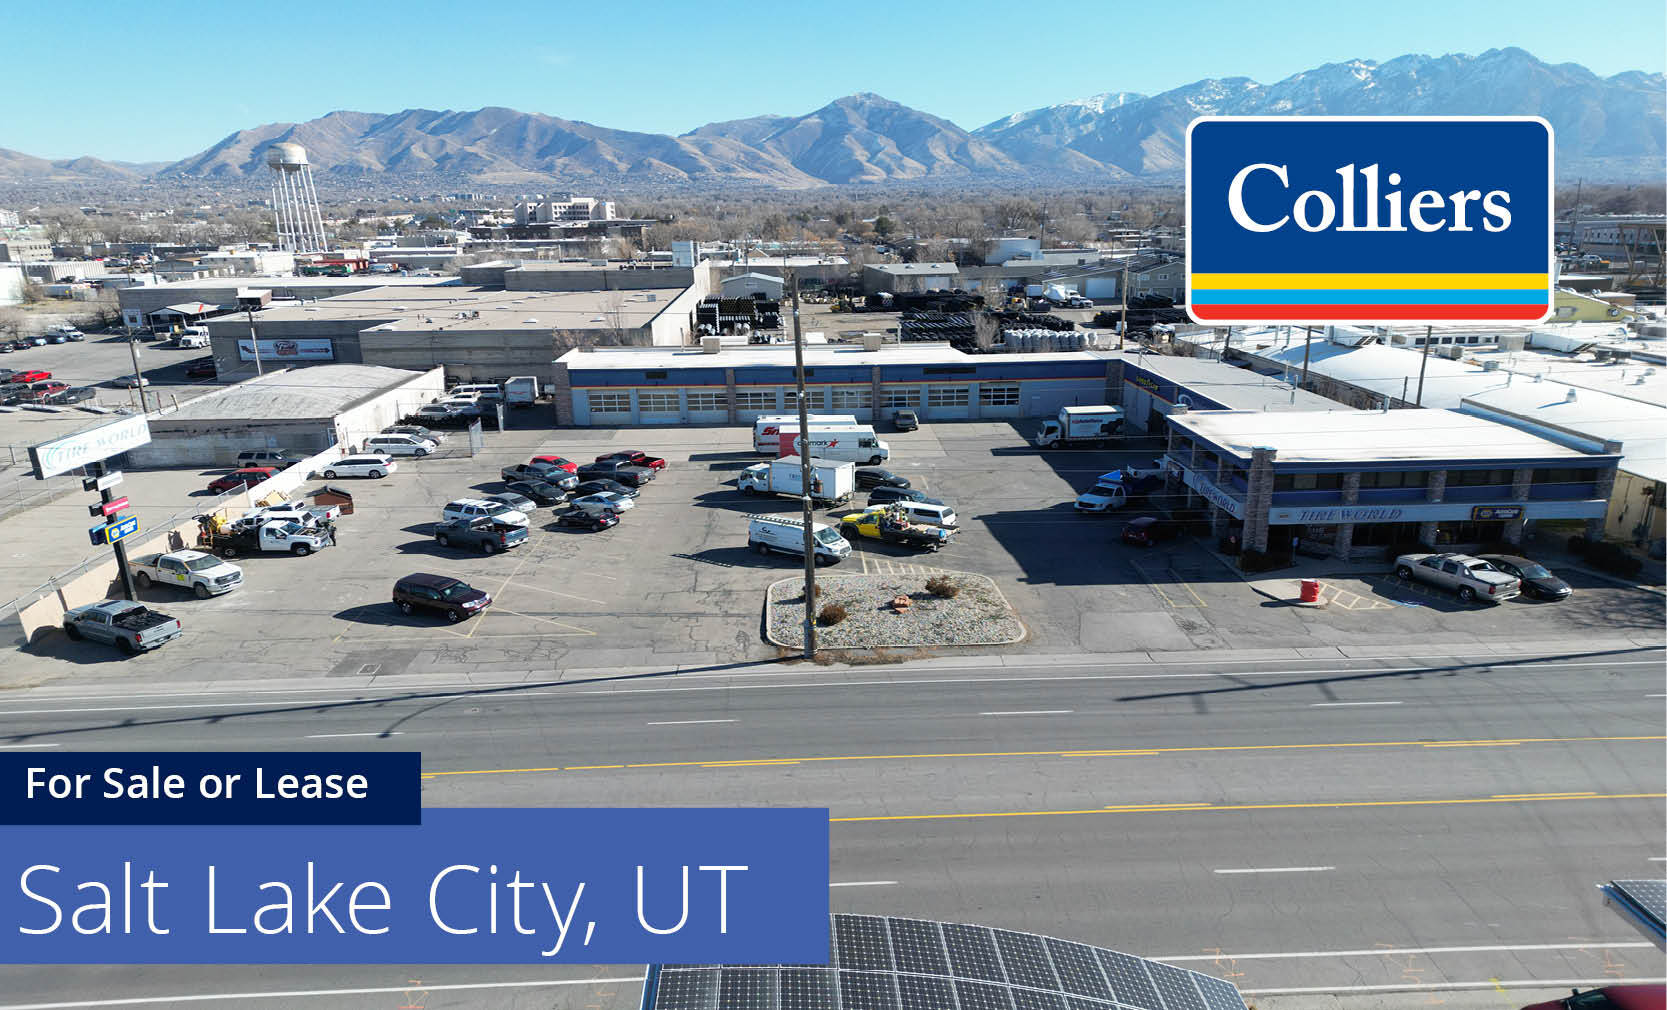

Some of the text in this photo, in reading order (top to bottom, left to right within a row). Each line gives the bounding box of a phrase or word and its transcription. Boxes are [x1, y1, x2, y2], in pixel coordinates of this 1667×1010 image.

[58, 423, 147, 462] TIRE WORLD
[1298, 508, 1402, 521] TIRE WORLD
